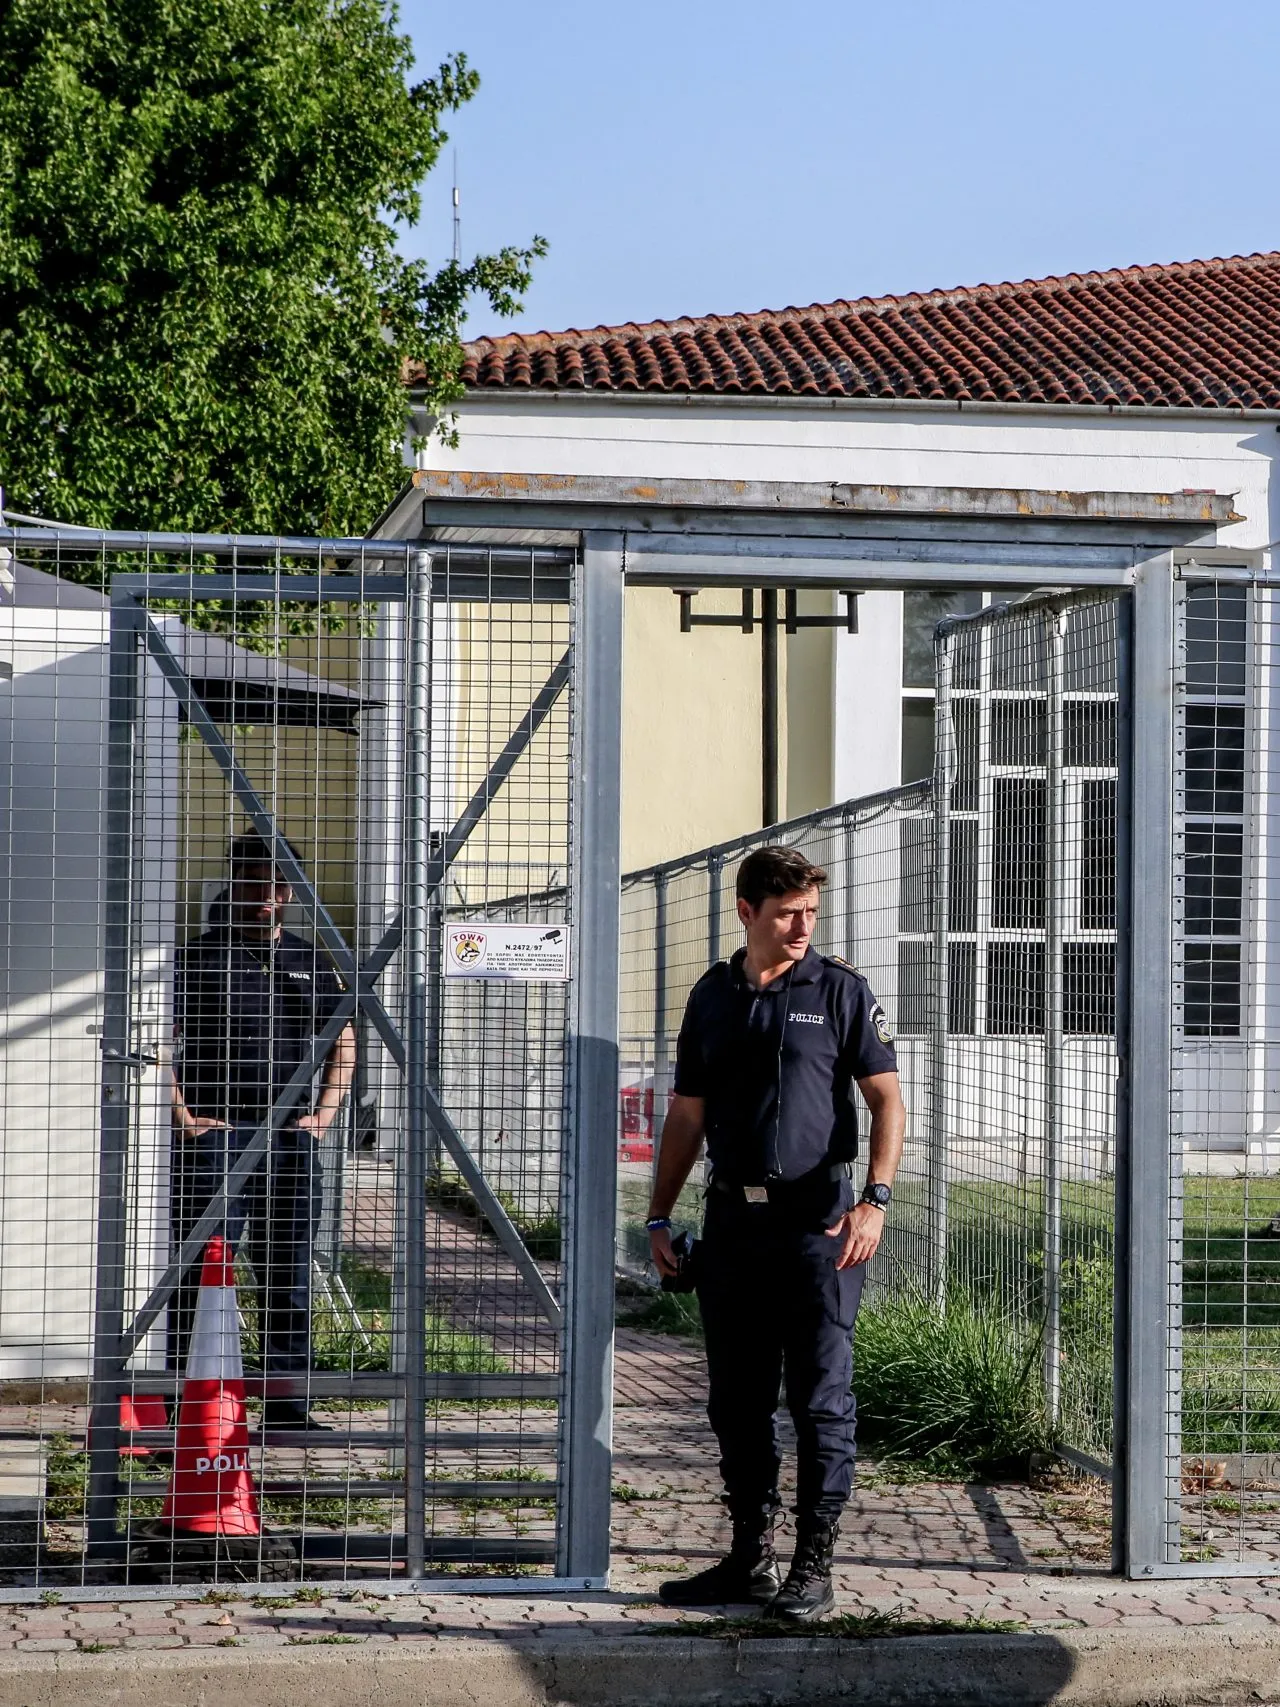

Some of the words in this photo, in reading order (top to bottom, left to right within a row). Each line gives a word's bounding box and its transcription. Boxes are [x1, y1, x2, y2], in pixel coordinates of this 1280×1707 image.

[452, 933, 484, 943] TOWN
[789, 1013, 824, 1024] POLICE
[196, 1452, 253, 1475] POLI
